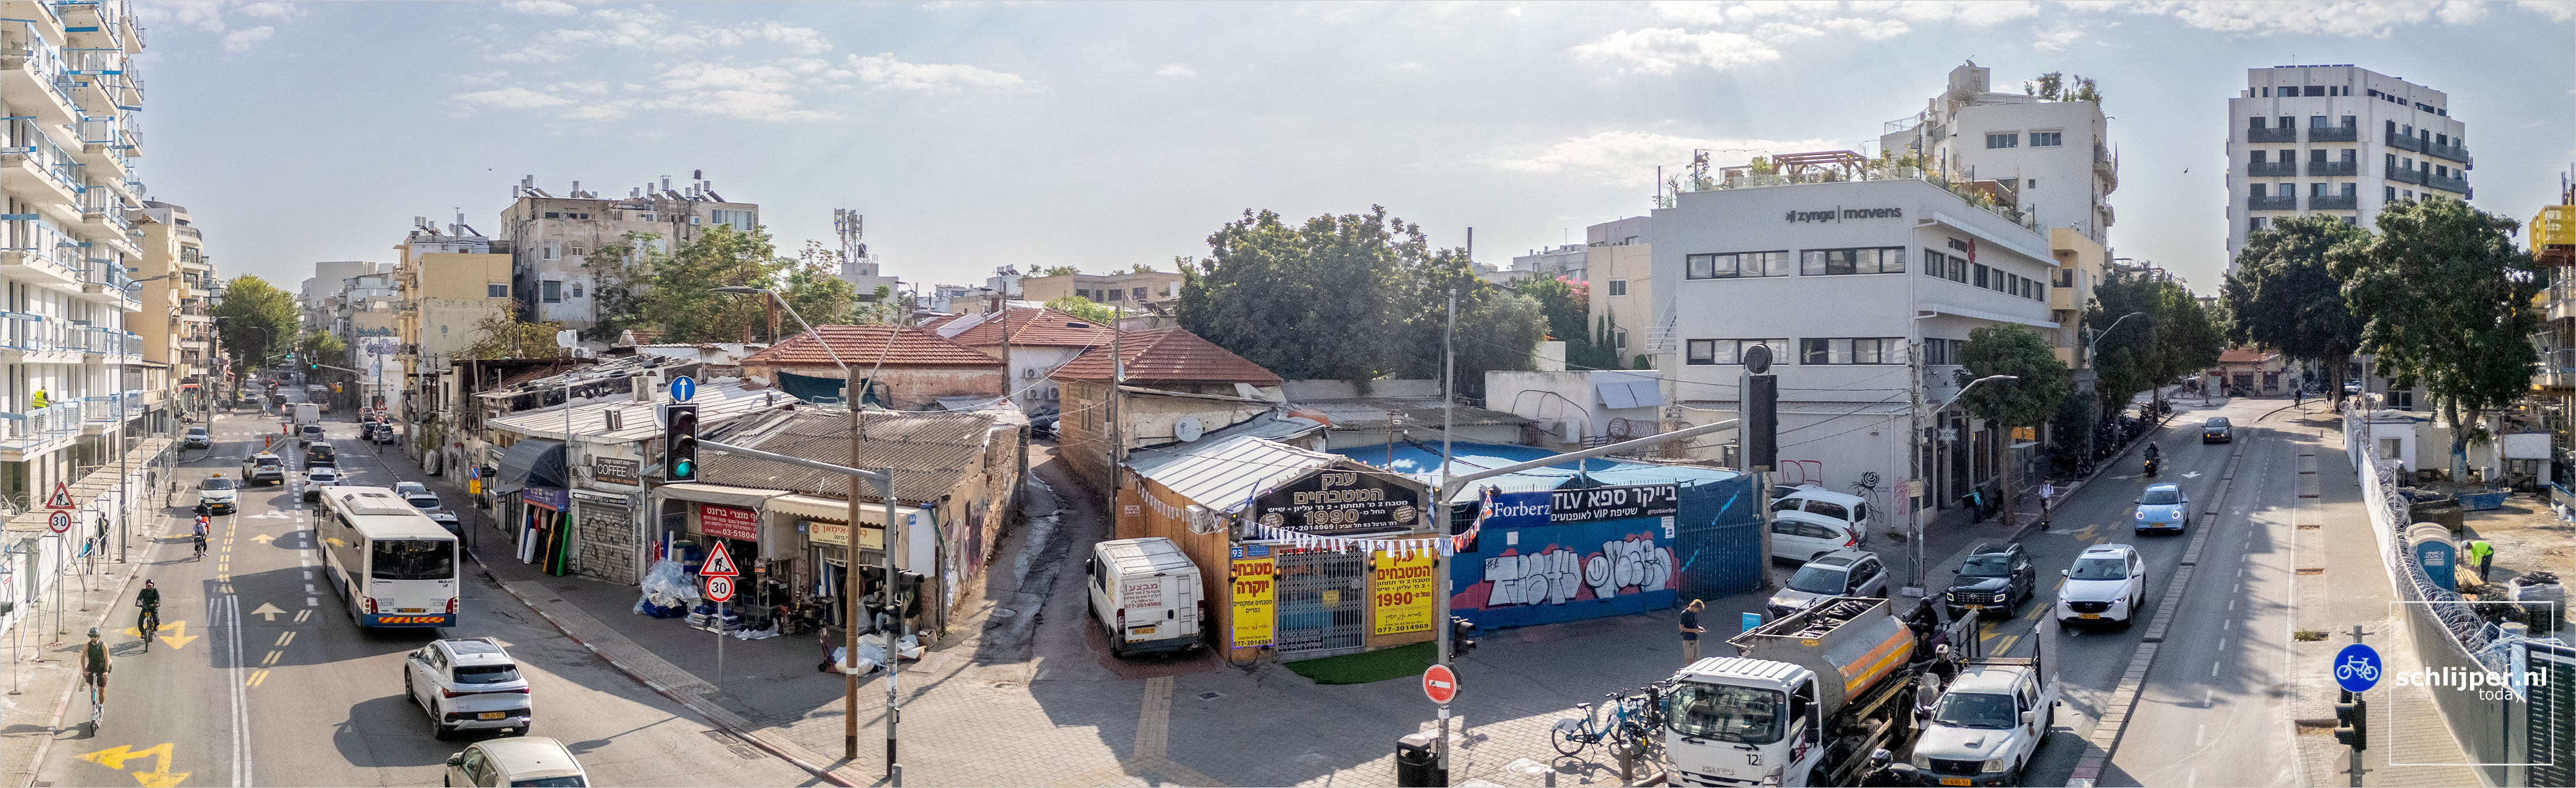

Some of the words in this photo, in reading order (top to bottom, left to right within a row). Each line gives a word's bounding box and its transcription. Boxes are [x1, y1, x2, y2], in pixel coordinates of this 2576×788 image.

[1797, 210, 1835, 223] zynga
[1843, 207, 1902, 219] mavens
[1321, 473, 1357, 490] ענק
[1293, 488, 1383, 505] המטבחים
[1553, 492, 1583, 510] TLV
[1588, 489, 1627, 508] ספא
[1632, 486, 1677, 507] בייקר
[707, 507, 727, 516] ברזנט
[1340, 502, 1365, 511] תחתון
[1494, 501, 1550, 517] Forberz
[1610, 507, 1638, 517] שטיפת
[1647, 508, 1677, 516] @TLVBikerSpa
[730, 510, 748, 519] מוצרי
[1551, 509, 1592, 521] לאופנועים
[1593, 509, 1608, 519] VIP
[53, 516, 66, 527] 30
[1232, 549, 1243, 557] 93
[1377, 565, 1430, 580] המטבחים
[711, 582, 726, 594] 30
[1124, 583, 1158, 592] מבצע!
[1236, 580, 1269, 598] יוקרה
[1377, 591, 1413, 607] 1990
[1377, 623, 1428, 633] 077-2014969
[1233, 639, 1272, 647] 077-2014969
[1746, 753, 1758, 766] 12
[1702, 766, 1735, 776] ISUZU
